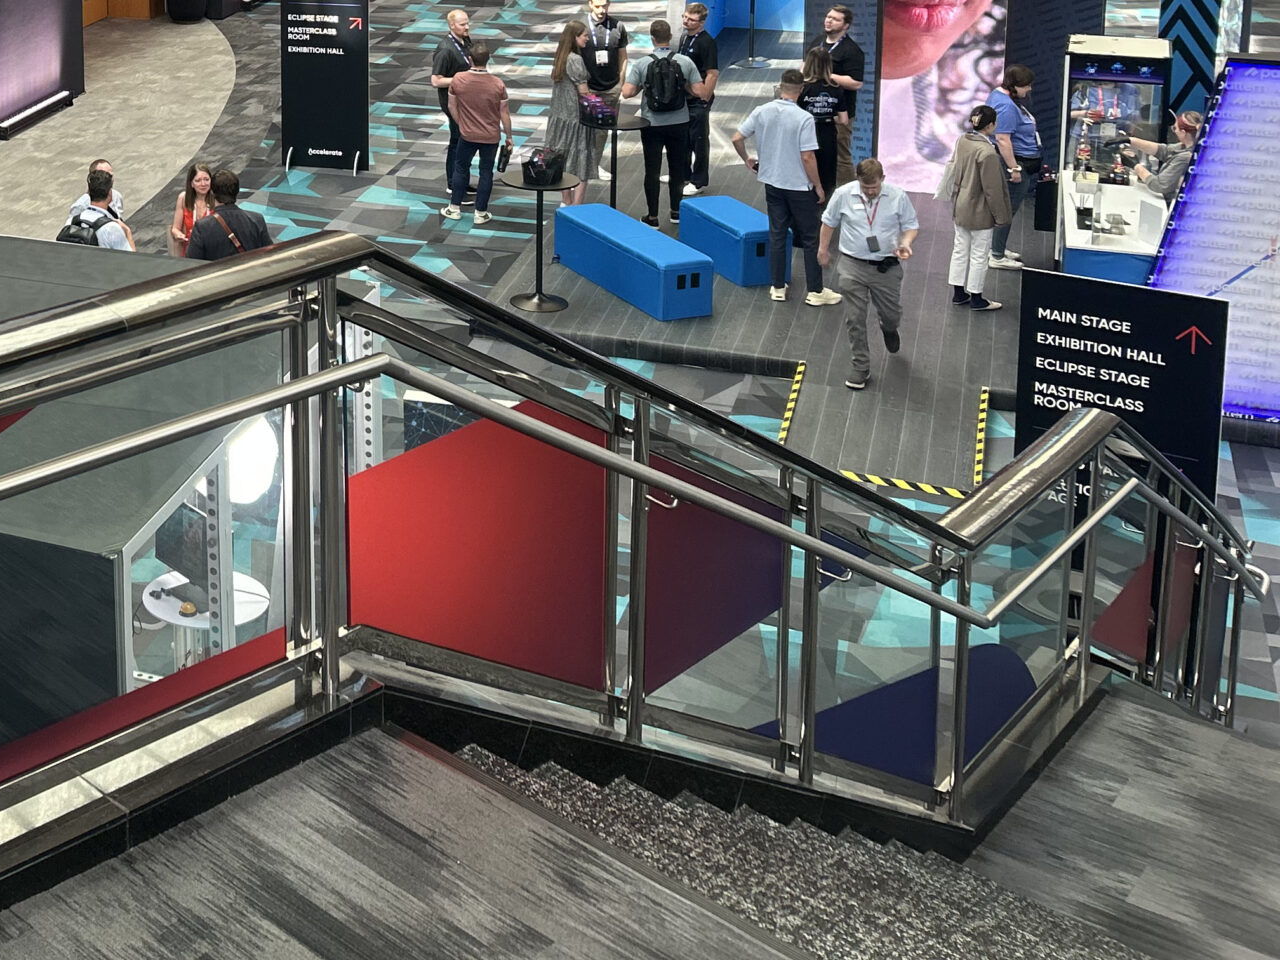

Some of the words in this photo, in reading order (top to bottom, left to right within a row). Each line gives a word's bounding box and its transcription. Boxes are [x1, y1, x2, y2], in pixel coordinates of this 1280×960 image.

[287, 14, 316, 22] ECLIPSE
[316, 15, 339, 23] STAGE
[287, 27, 337, 35] MASTERCLASS
[287, 33, 310, 41] ROOM
[287, 46, 326, 55] EXHIBITION
[327, 47, 344, 55] HALL
[308, 148, 343, 156] Accelerate
[1038, 307, 1077, 325] MAIN
[1081, 315, 1131, 334] STAGE
[1036, 332, 1122, 358] EXHIBITION
[1126, 348, 1166, 366] HALL
[1035, 357, 1096, 378] ECLIPSE
[1099, 369, 1150, 389] STAGE
[1034, 381, 1145, 413] MASTERCLASS
